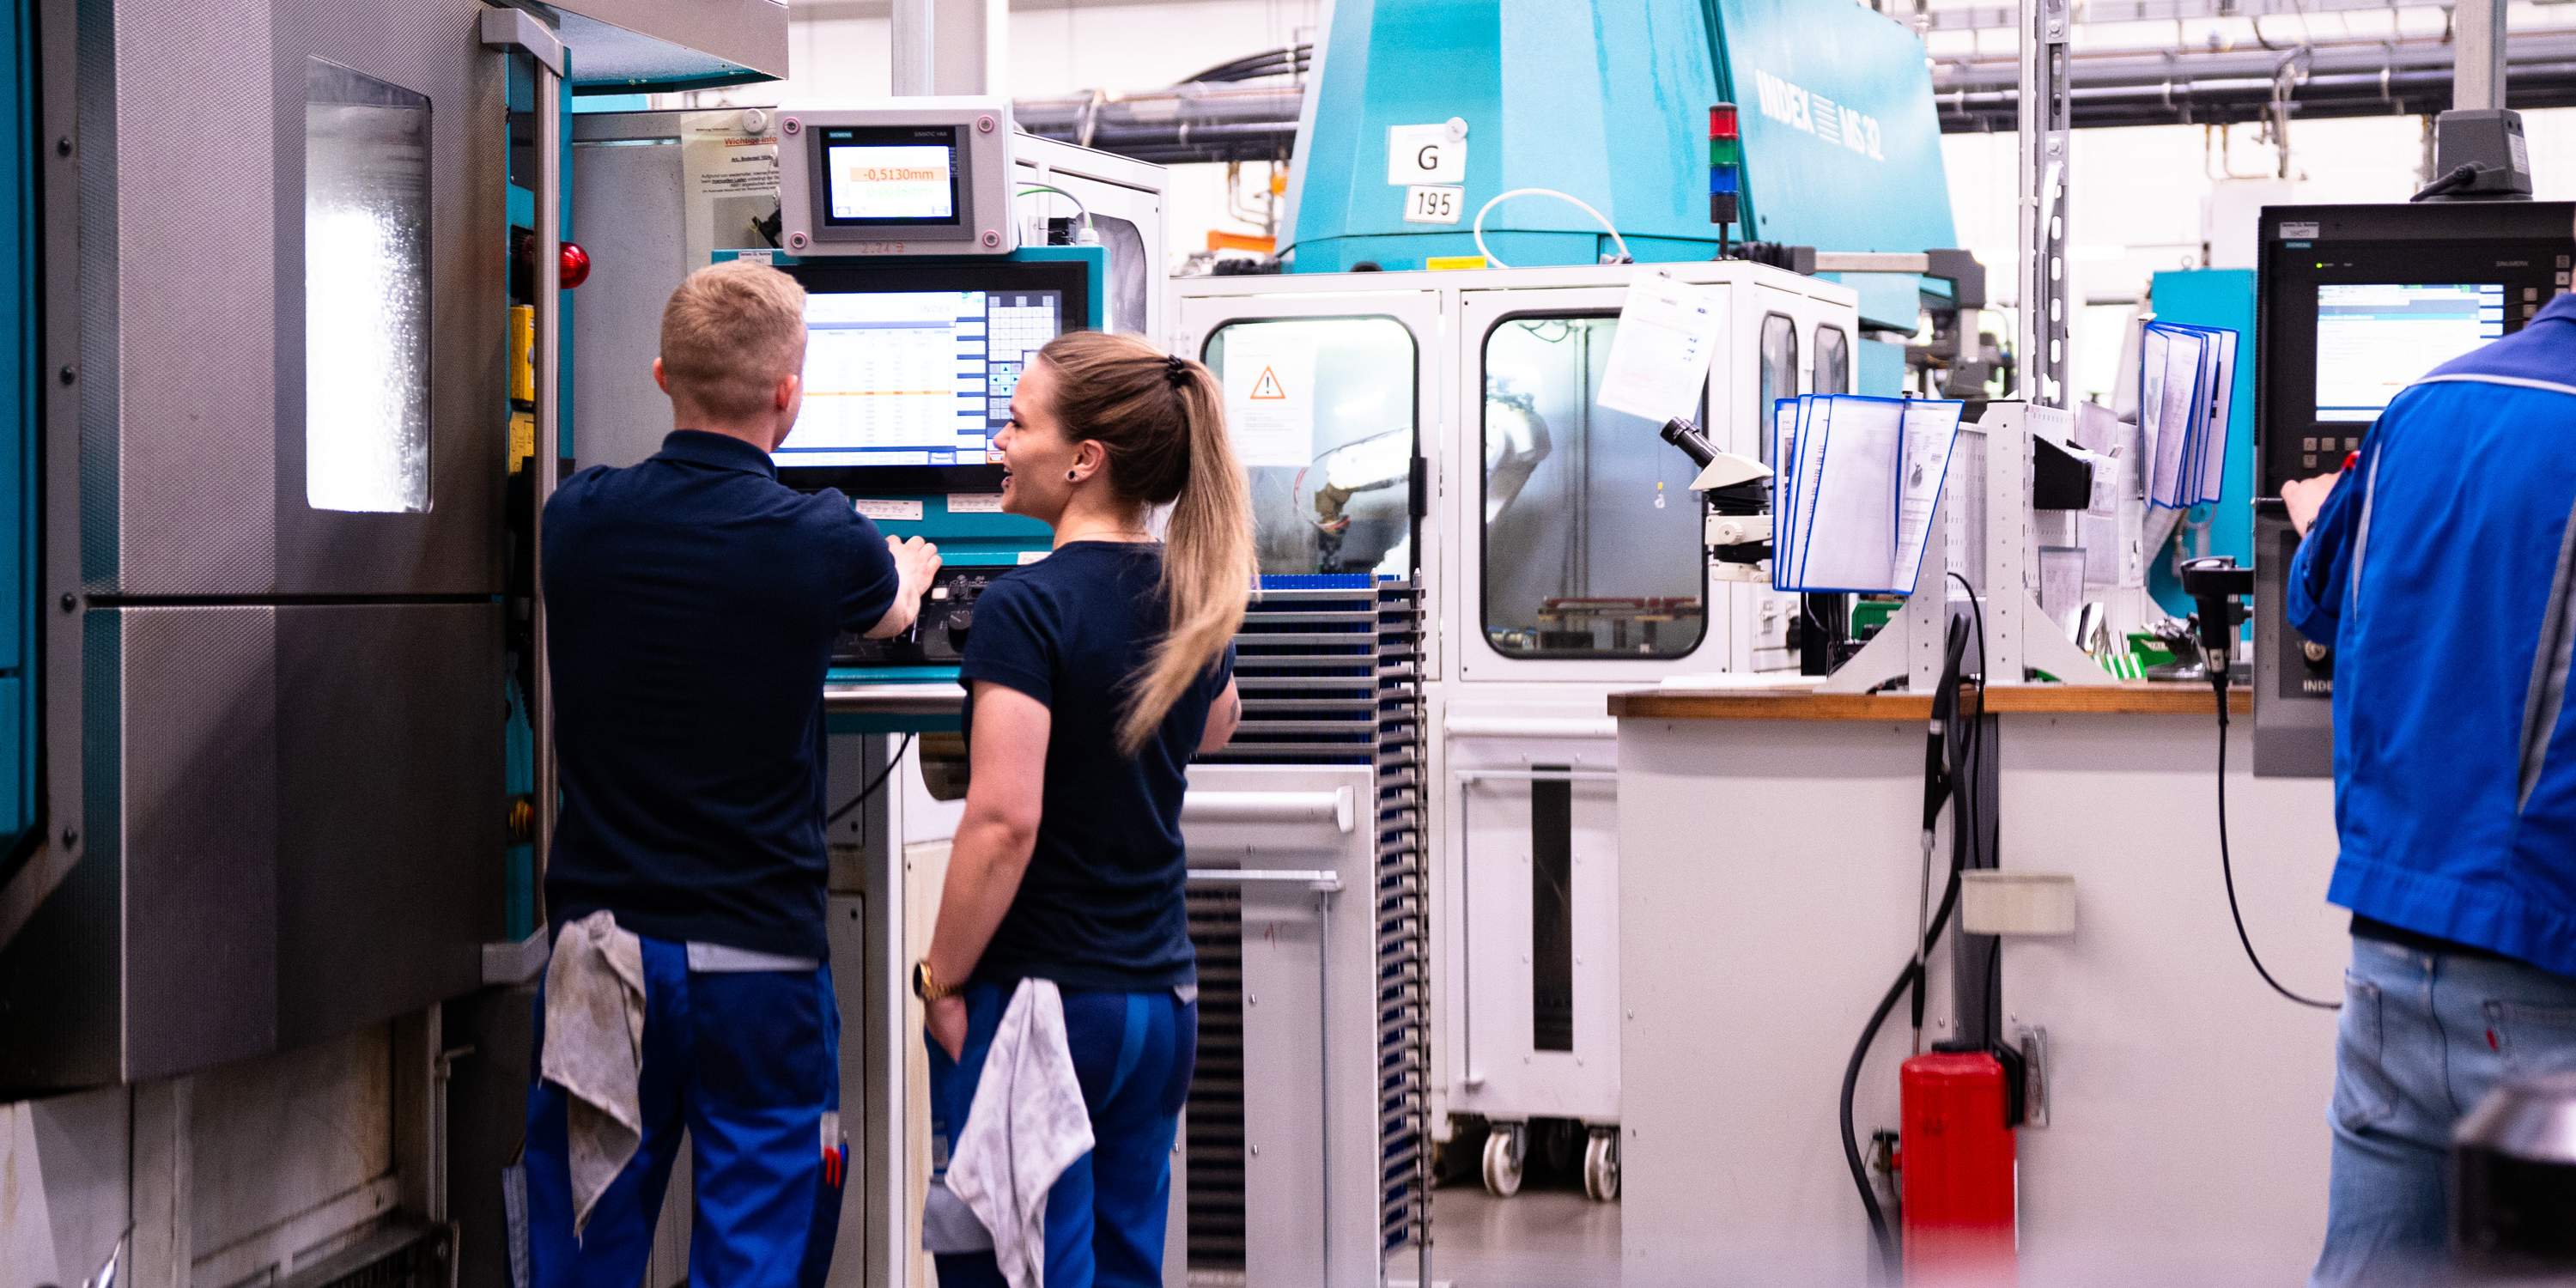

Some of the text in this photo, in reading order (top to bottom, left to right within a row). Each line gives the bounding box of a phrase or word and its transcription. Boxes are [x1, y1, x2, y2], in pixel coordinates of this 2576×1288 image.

[1755, 69, 1816, 134] INDEX
[1837, 104, 1866, 155] MS
[724, 137, 760, 146] Wichtige
[1418, 144, 1439, 171] G
[863, 168, 934, 182] -0,5130mm
[1418, 191, 1452, 216] 195
[2303, 679, 2333, 692] INDE
